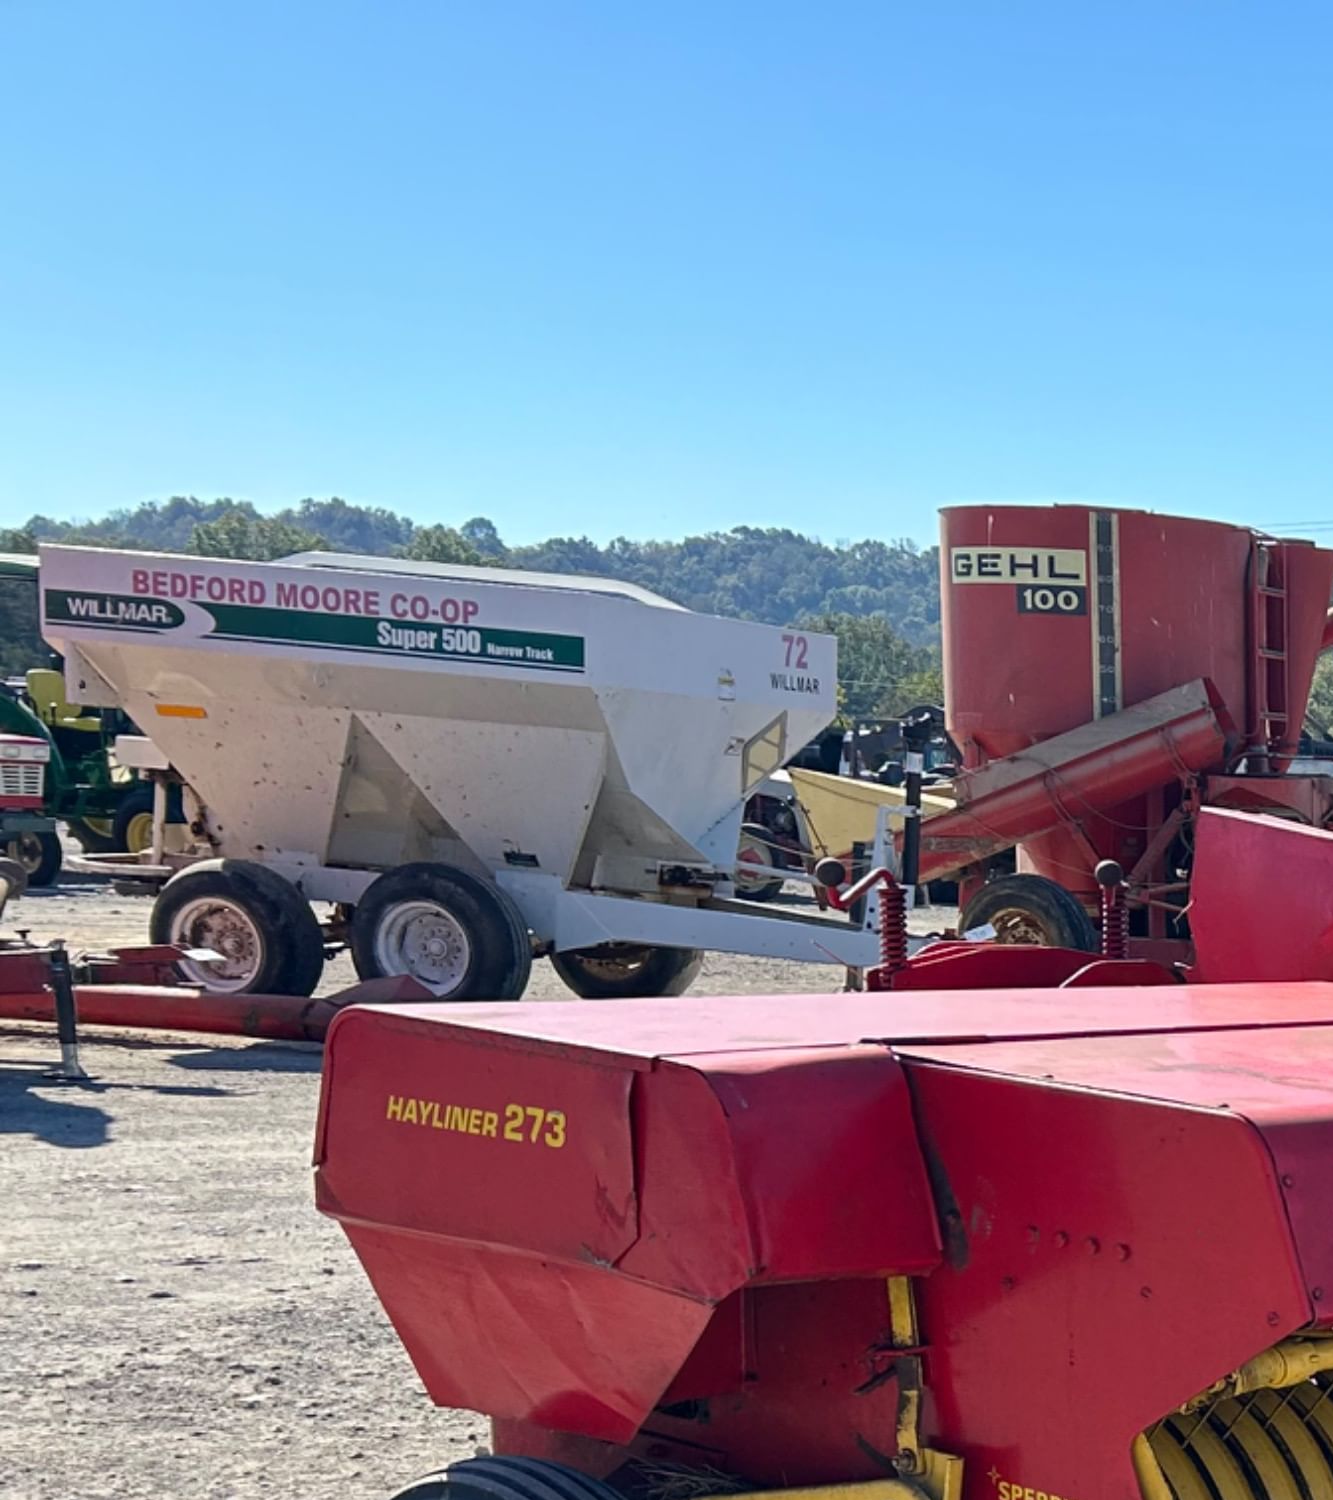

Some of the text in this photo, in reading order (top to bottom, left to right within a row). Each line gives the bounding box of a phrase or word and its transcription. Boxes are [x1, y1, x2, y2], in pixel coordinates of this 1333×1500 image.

[954, 553, 1081, 579] GEHL
[67, 597, 168, 622] WILLMAR
[132, 570, 479, 624] BEDFORD MOORE CO-OP
[1024, 588, 1080, 610] 100
[377, 621, 554, 660] Super 500 Narrow Track
[782, 635, 808, 669] 72
[770, 673, 819, 694] WILLMAR
[386, 1095, 566, 1147] HAYLINER 273
